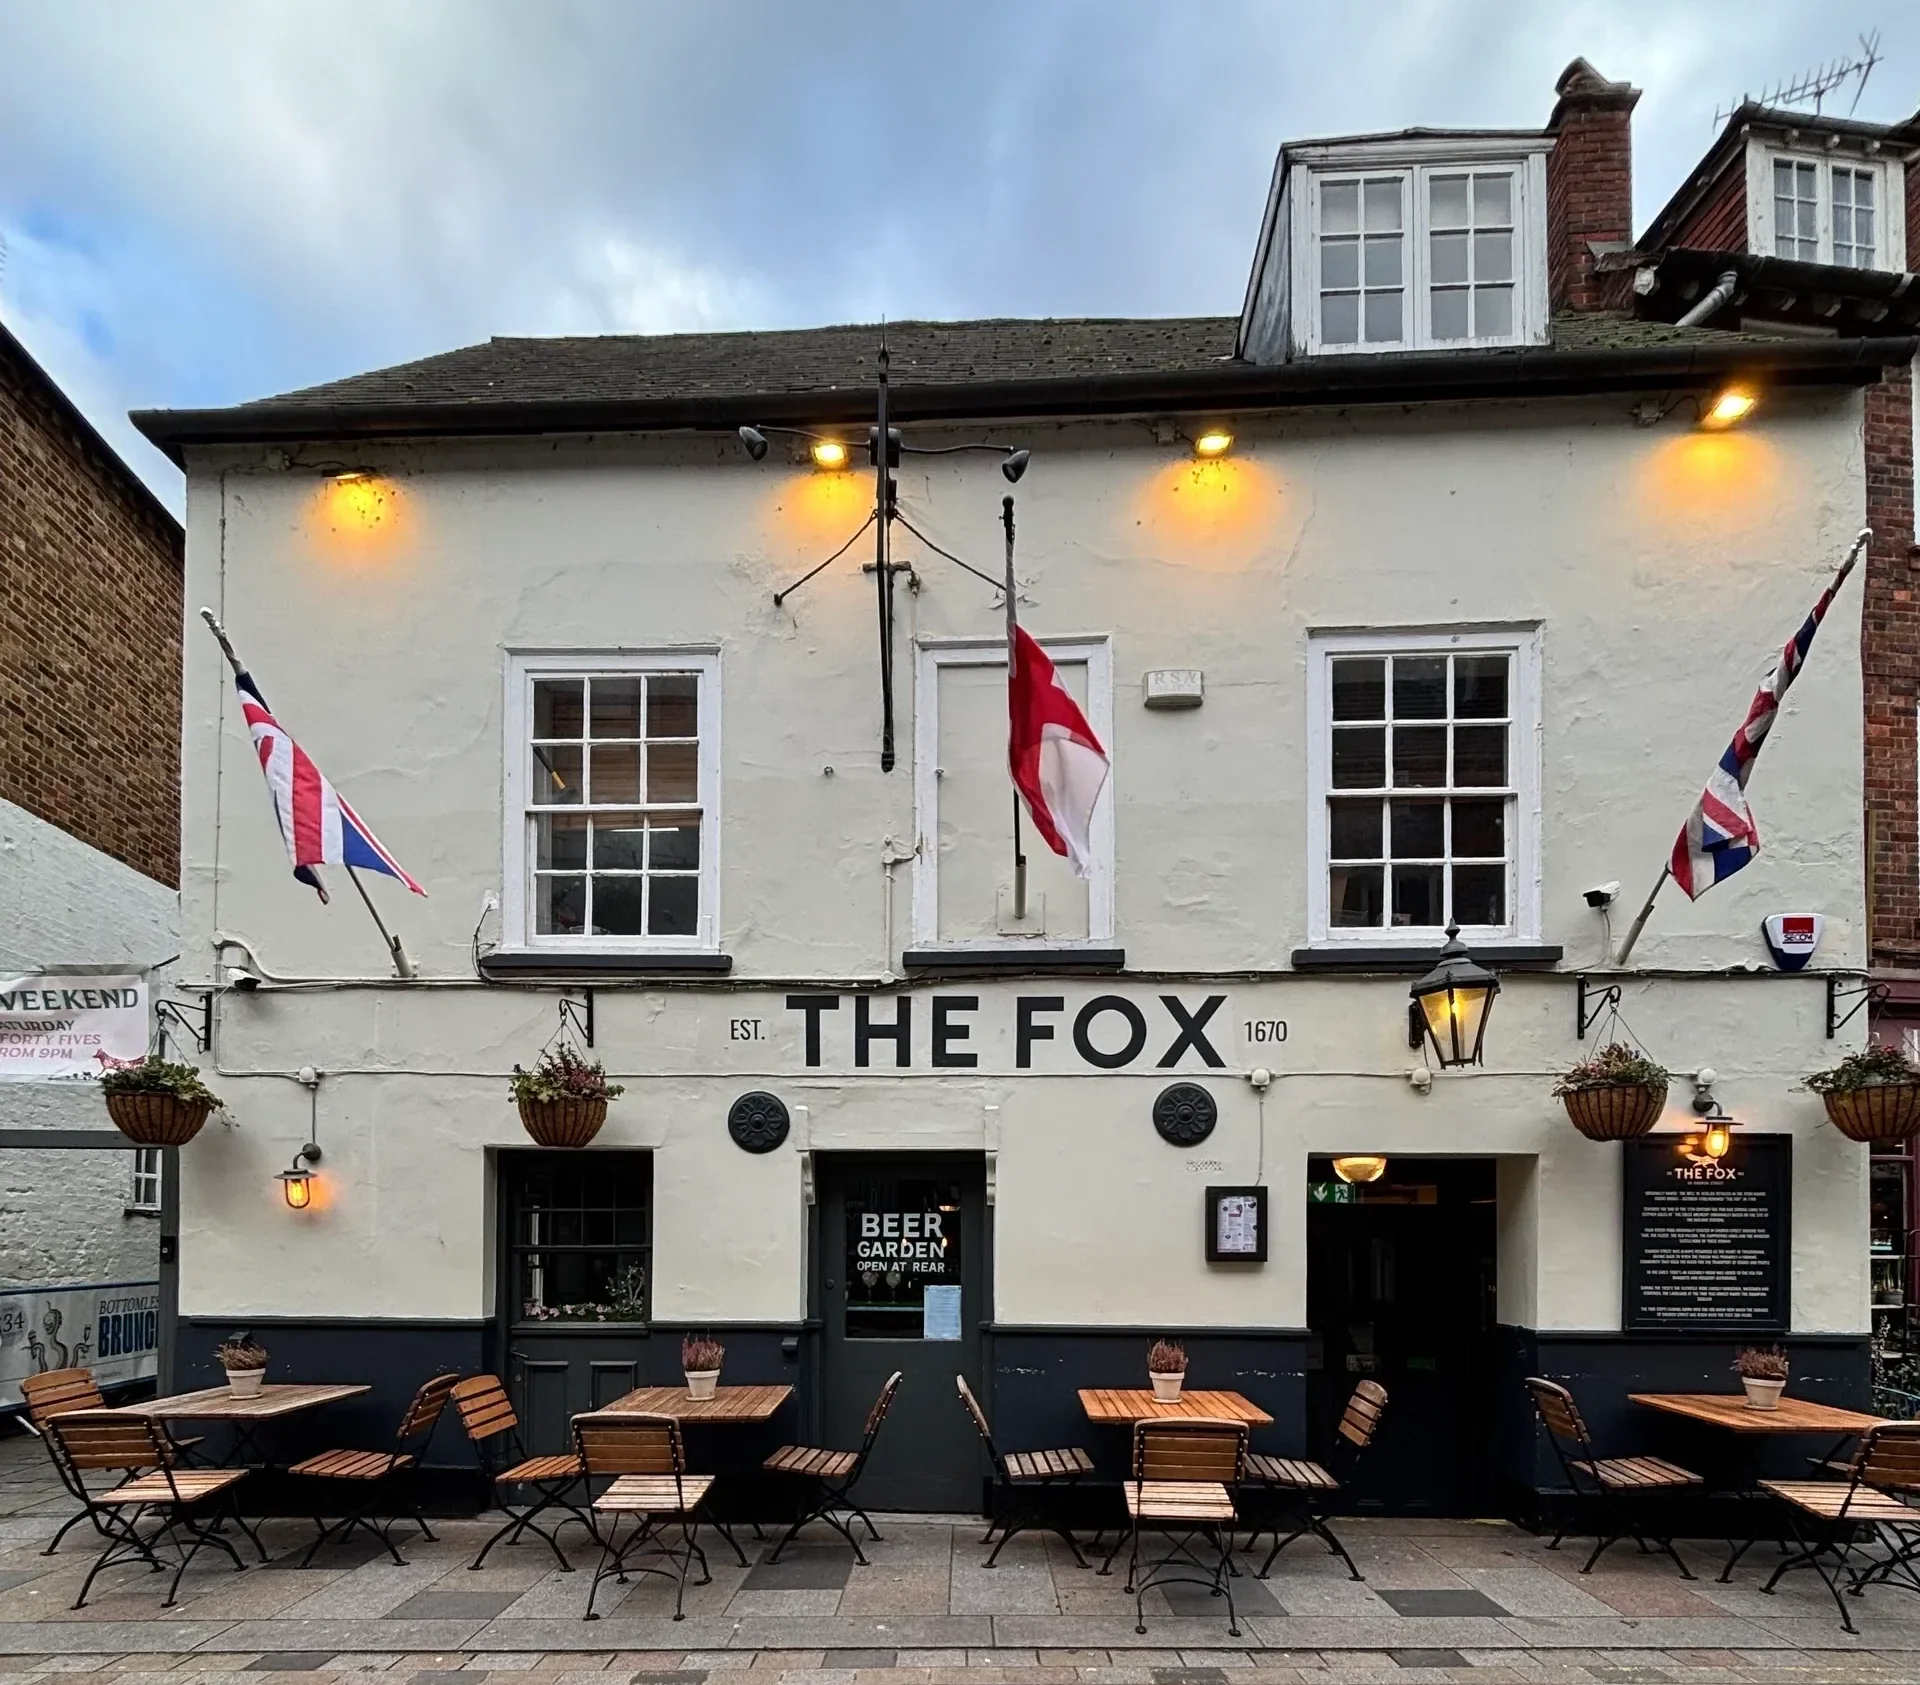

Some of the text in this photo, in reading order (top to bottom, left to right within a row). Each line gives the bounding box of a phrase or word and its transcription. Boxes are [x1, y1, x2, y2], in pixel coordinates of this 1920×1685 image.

[0, 1020, 75, 1031] ATURDAY
[731, 1019, 765, 1040] EST.
[786, 995, 1227, 1068] THE FOX
[1244, 1020, 1287, 1042] 1670
[59, 1034, 101, 1045] FIVES
[0, 1047, 73, 1059] ROM 9PM
[1674, 1168, 1703, 1179] THE
[1706, 1168, 1736, 1179] FOX
[861, 1213, 943, 1237] BEER
[857, 1241, 945, 1258] GARDEN
[857, 1261, 945, 1273] OPEN AT REAR
[0, 1311, 25, 1333] 34
